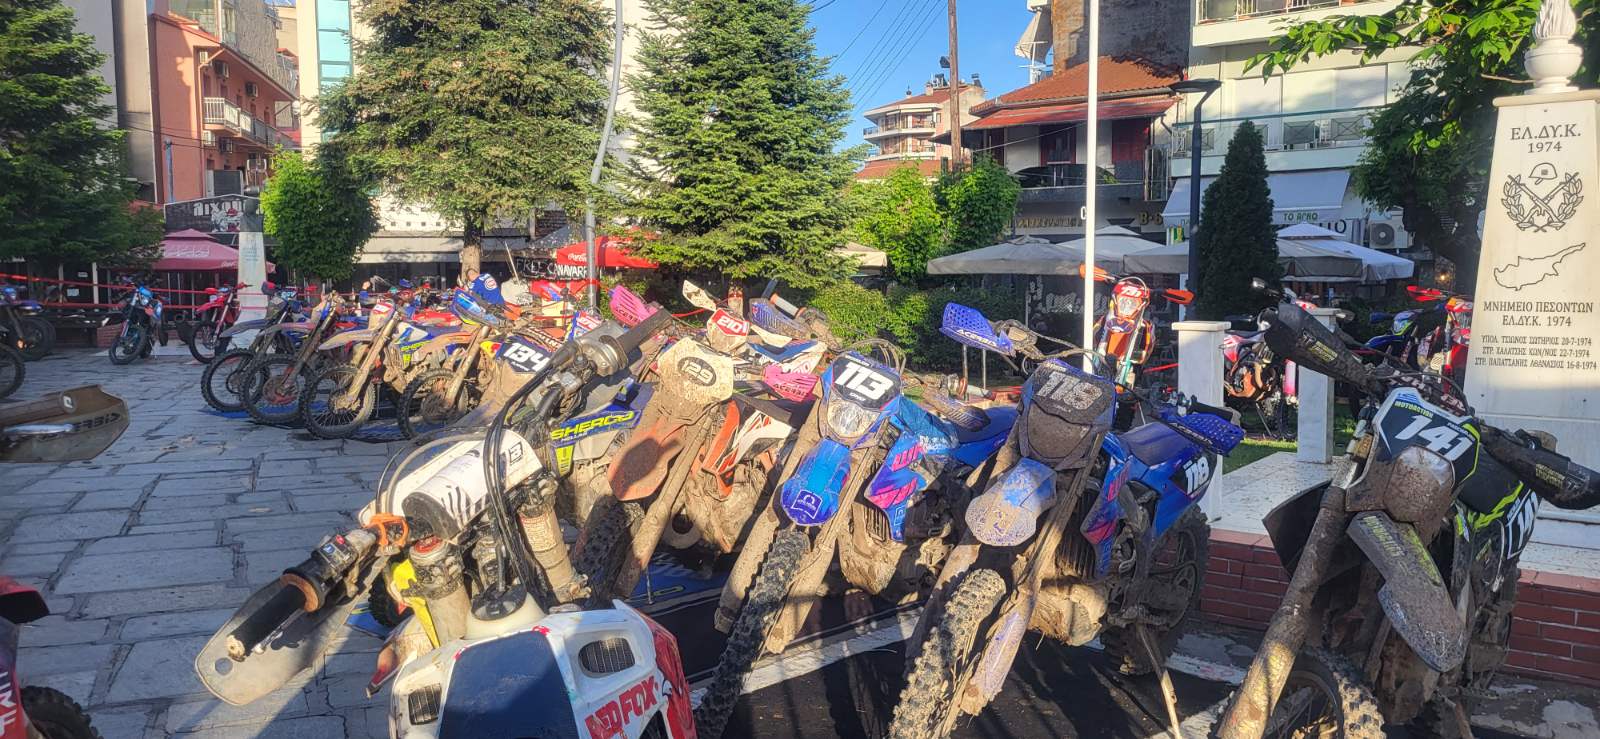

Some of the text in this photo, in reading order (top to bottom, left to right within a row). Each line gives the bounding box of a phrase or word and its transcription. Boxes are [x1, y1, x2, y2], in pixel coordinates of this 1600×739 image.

[1510, 123, 1581, 140] ΕΛ.ΔΥ.Κ.
[1528, 141, 1563, 153] 1974
[1484, 301, 1533, 312] ΜΝΗΜΕΙΟ
[1535, 302, 1594, 313] ΠΕΣΟΝΤΩΝ
[717, 315, 742, 333] 210
[1502, 315, 1573, 327] ΕΛ.ΔΥ.Κ. 1974
[503, 342, 551, 372] 134
[1560, 349, 1591, 359] 22-7-1974
[681, 360, 714, 384] 129
[834, 361, 894, 400] 113
[1036, 371, 1103, 410] 118
[550, 410, 635, 440] SHERCO
[1395, 415, 1473, 461] 141
[1184, 456, 1210, 494] 118
[619, 675, 658, 725] FOX
